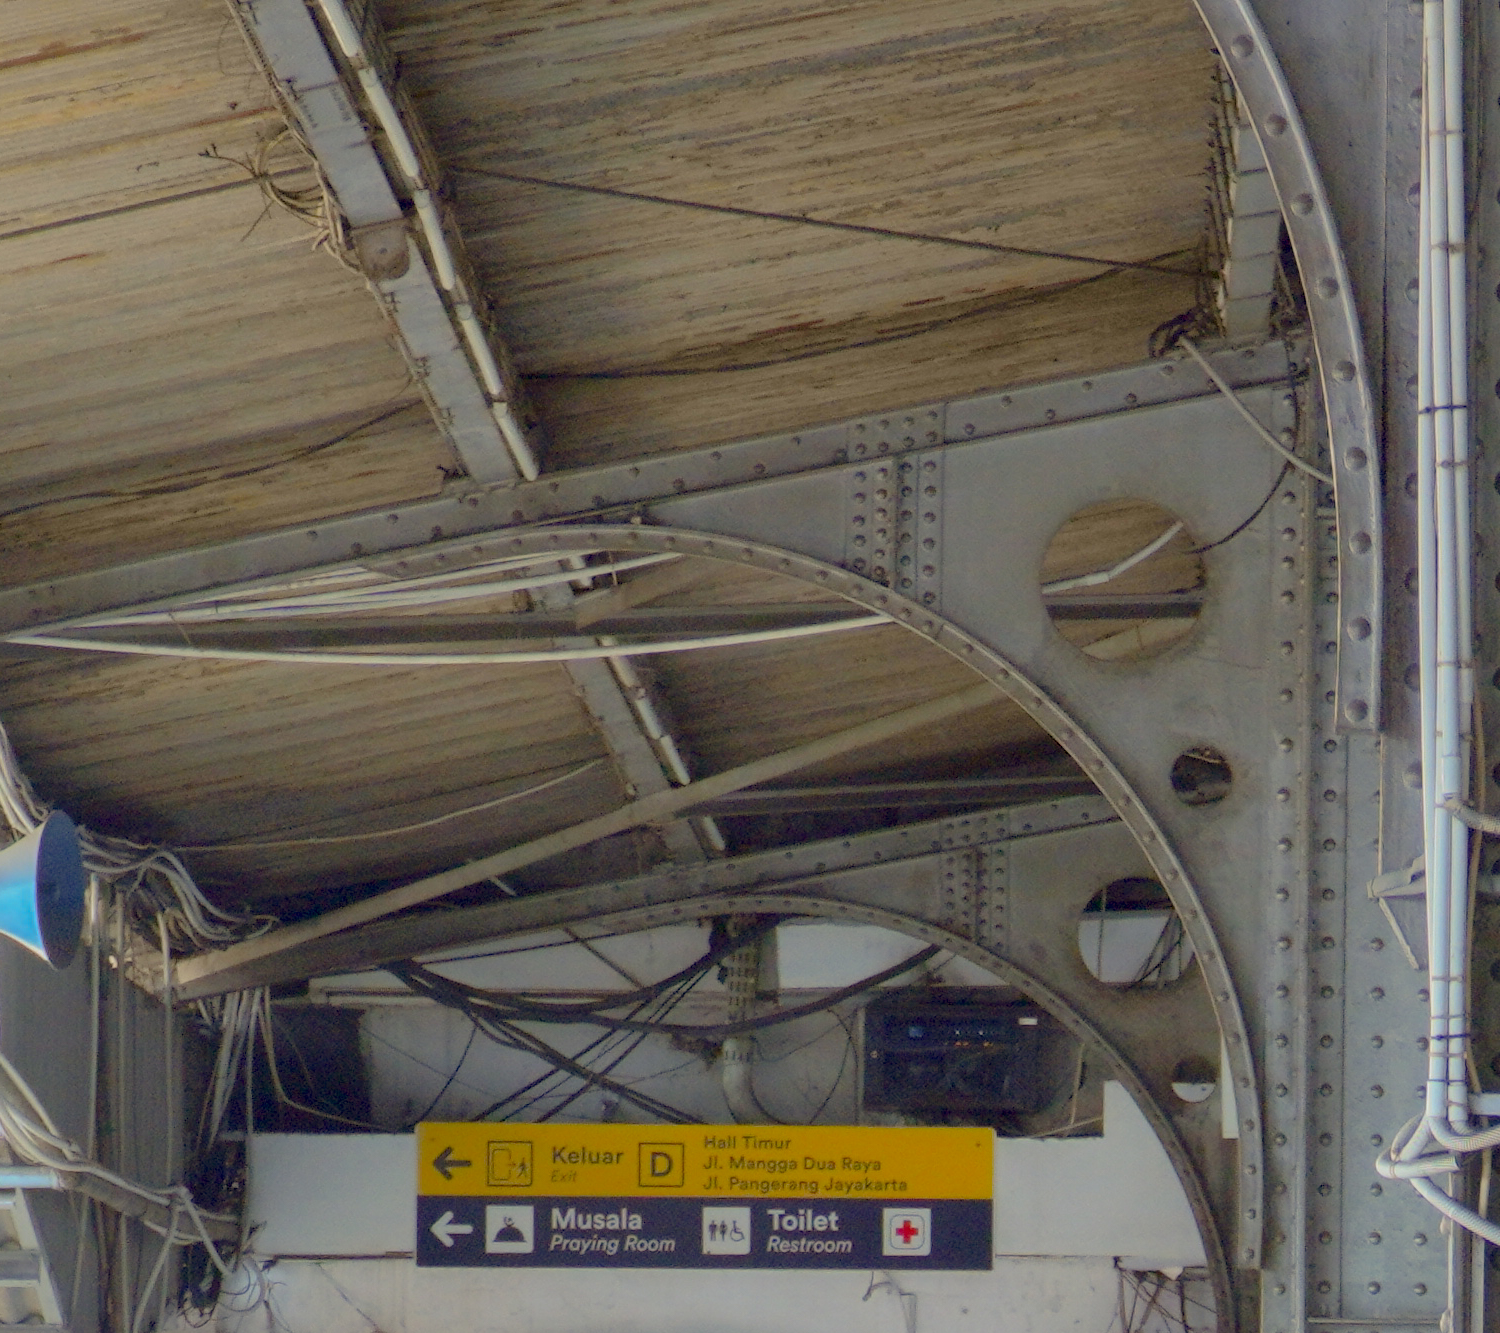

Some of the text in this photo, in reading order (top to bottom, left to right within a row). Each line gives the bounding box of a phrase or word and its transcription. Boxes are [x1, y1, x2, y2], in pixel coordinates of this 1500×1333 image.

[704, 1136, 792, 1150] Hall Timur
[551, 1146, 623, 1166] Keluar
[650, 1152, 673, 1178] D
[703, 1156, 882, 1174] Jl. Mangga Dua Raya
[551, 1169, 577, 1184] Exit
[703, 1176, 723, 1191] Jl.
[824, 1177, 908, 1195] Jayakarta
[550, 1207, 643, 1231] Musala
[767, 1210, 839, 1232] Toilet
[550, 1235, 676, 1256] Praying Room
[767, 1236, 853, 1254] Restroom
